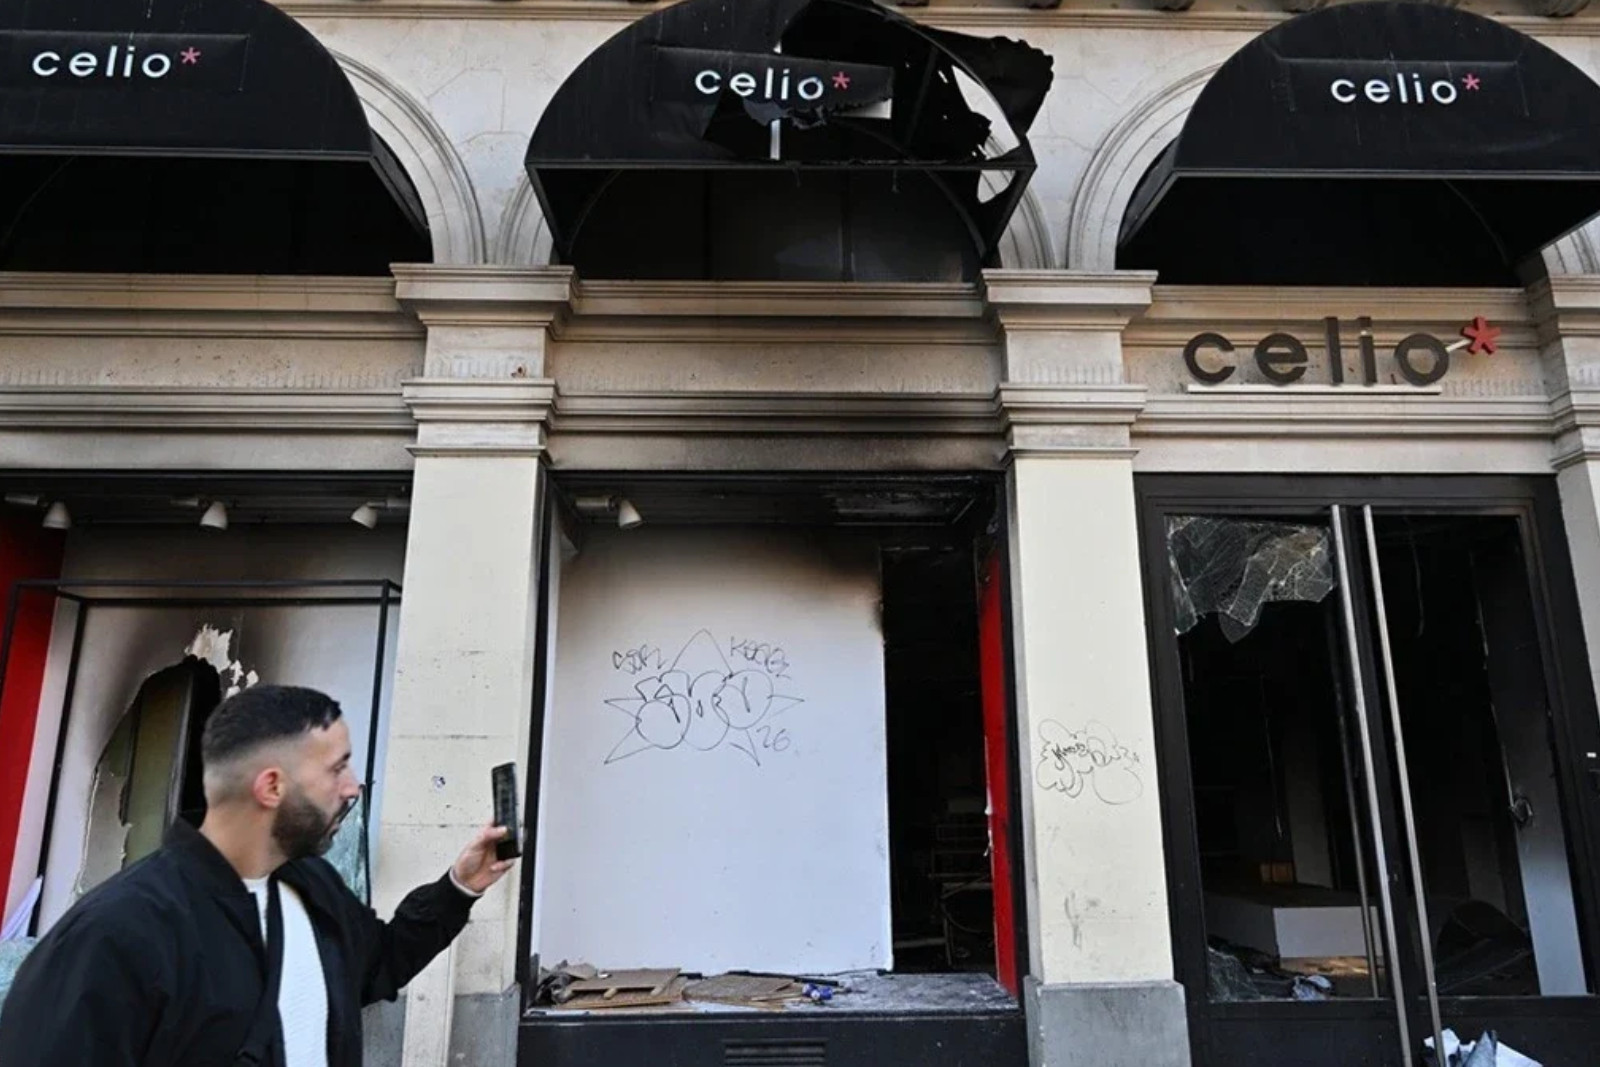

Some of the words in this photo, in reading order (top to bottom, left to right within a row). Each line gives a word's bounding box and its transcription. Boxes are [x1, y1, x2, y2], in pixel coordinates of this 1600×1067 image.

[32, 45, 171, 78] celio
[695, 67, 824, 100] celio
[1331, 72, 1457, 104] celio
[1183, 316, 1450, 386] celio
